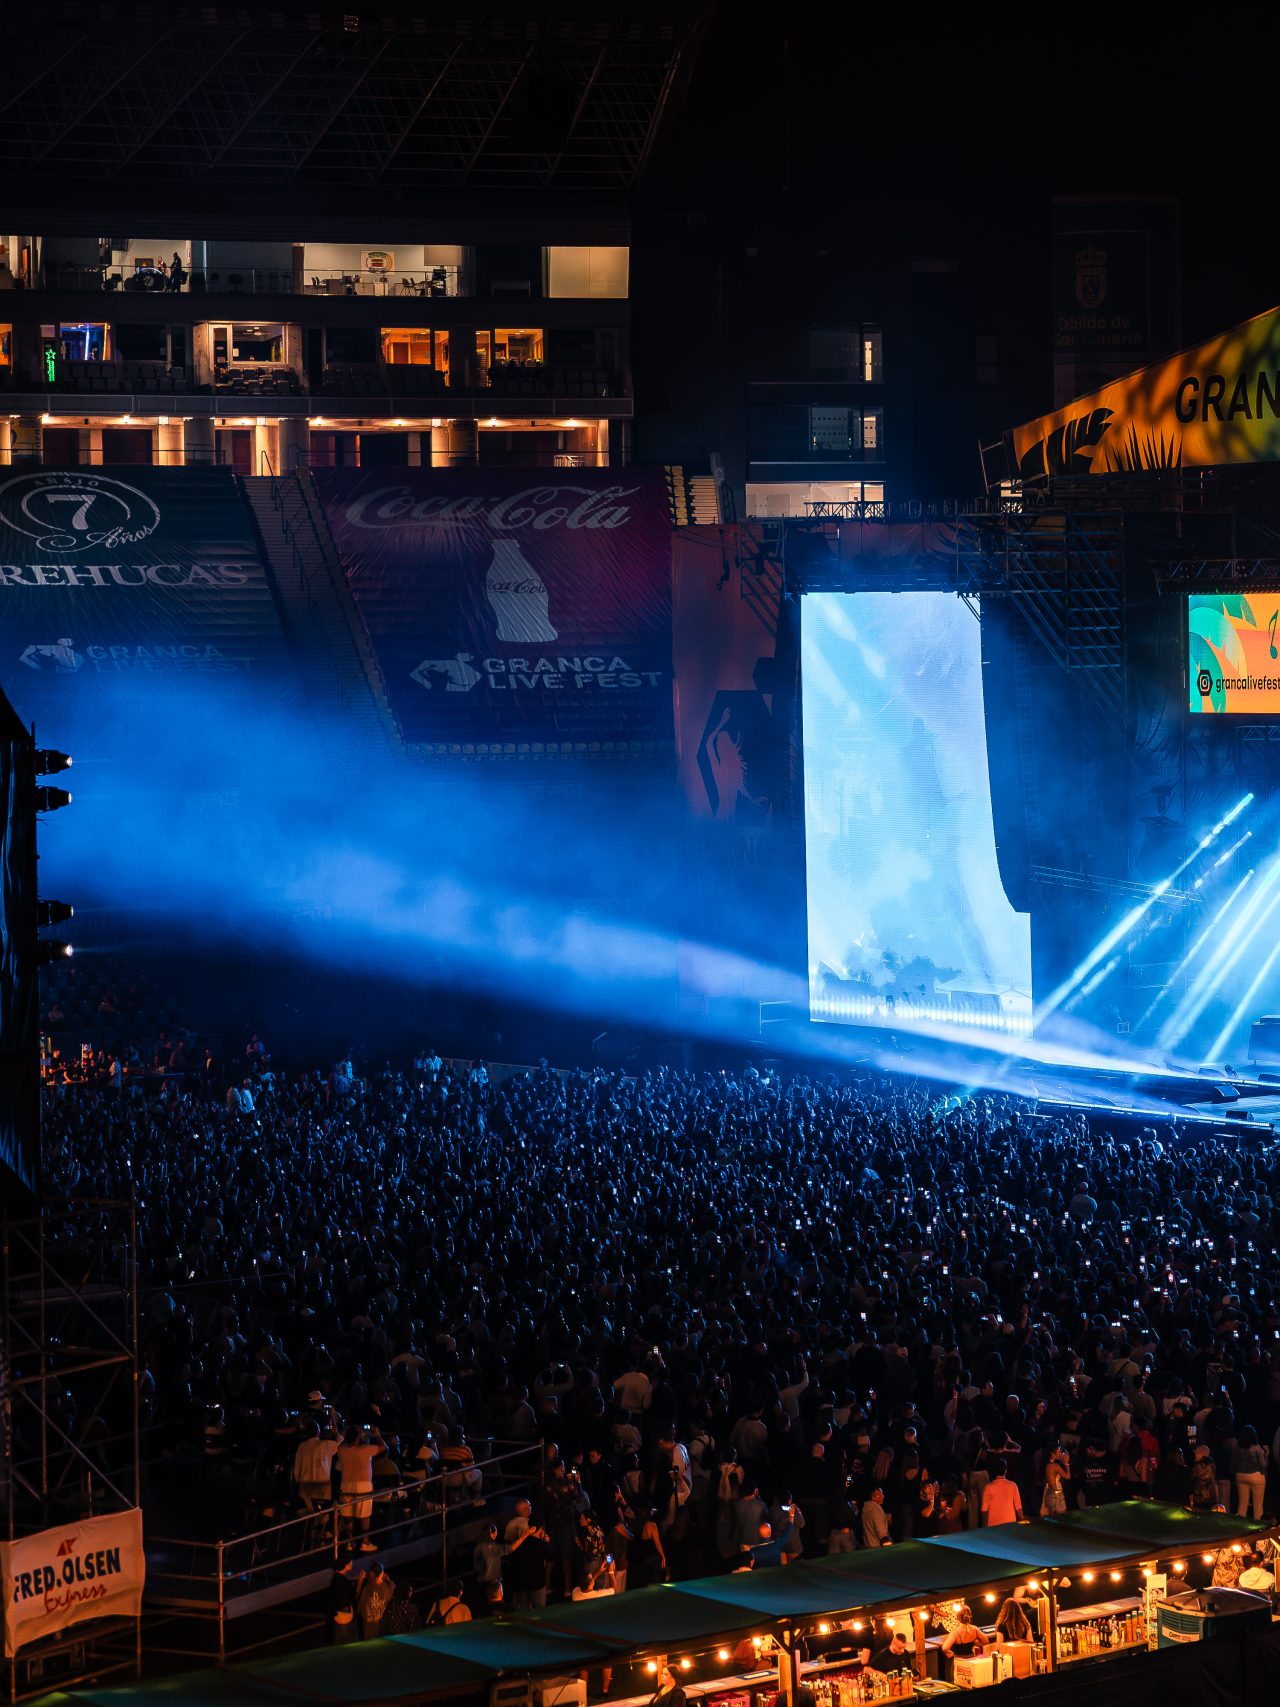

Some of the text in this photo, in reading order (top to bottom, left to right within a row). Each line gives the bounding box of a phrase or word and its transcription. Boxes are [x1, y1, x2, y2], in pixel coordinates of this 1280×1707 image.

[1111, 314, 1131, 329] de
[45, 494, 97, 530] 7
[86, 645, 225, 659] GRANCA
[482, 656, 632, 673] GRANCA
[488, 671, 663, 689] LIVE FEST
[44, 1583, 107, 1614] Express
